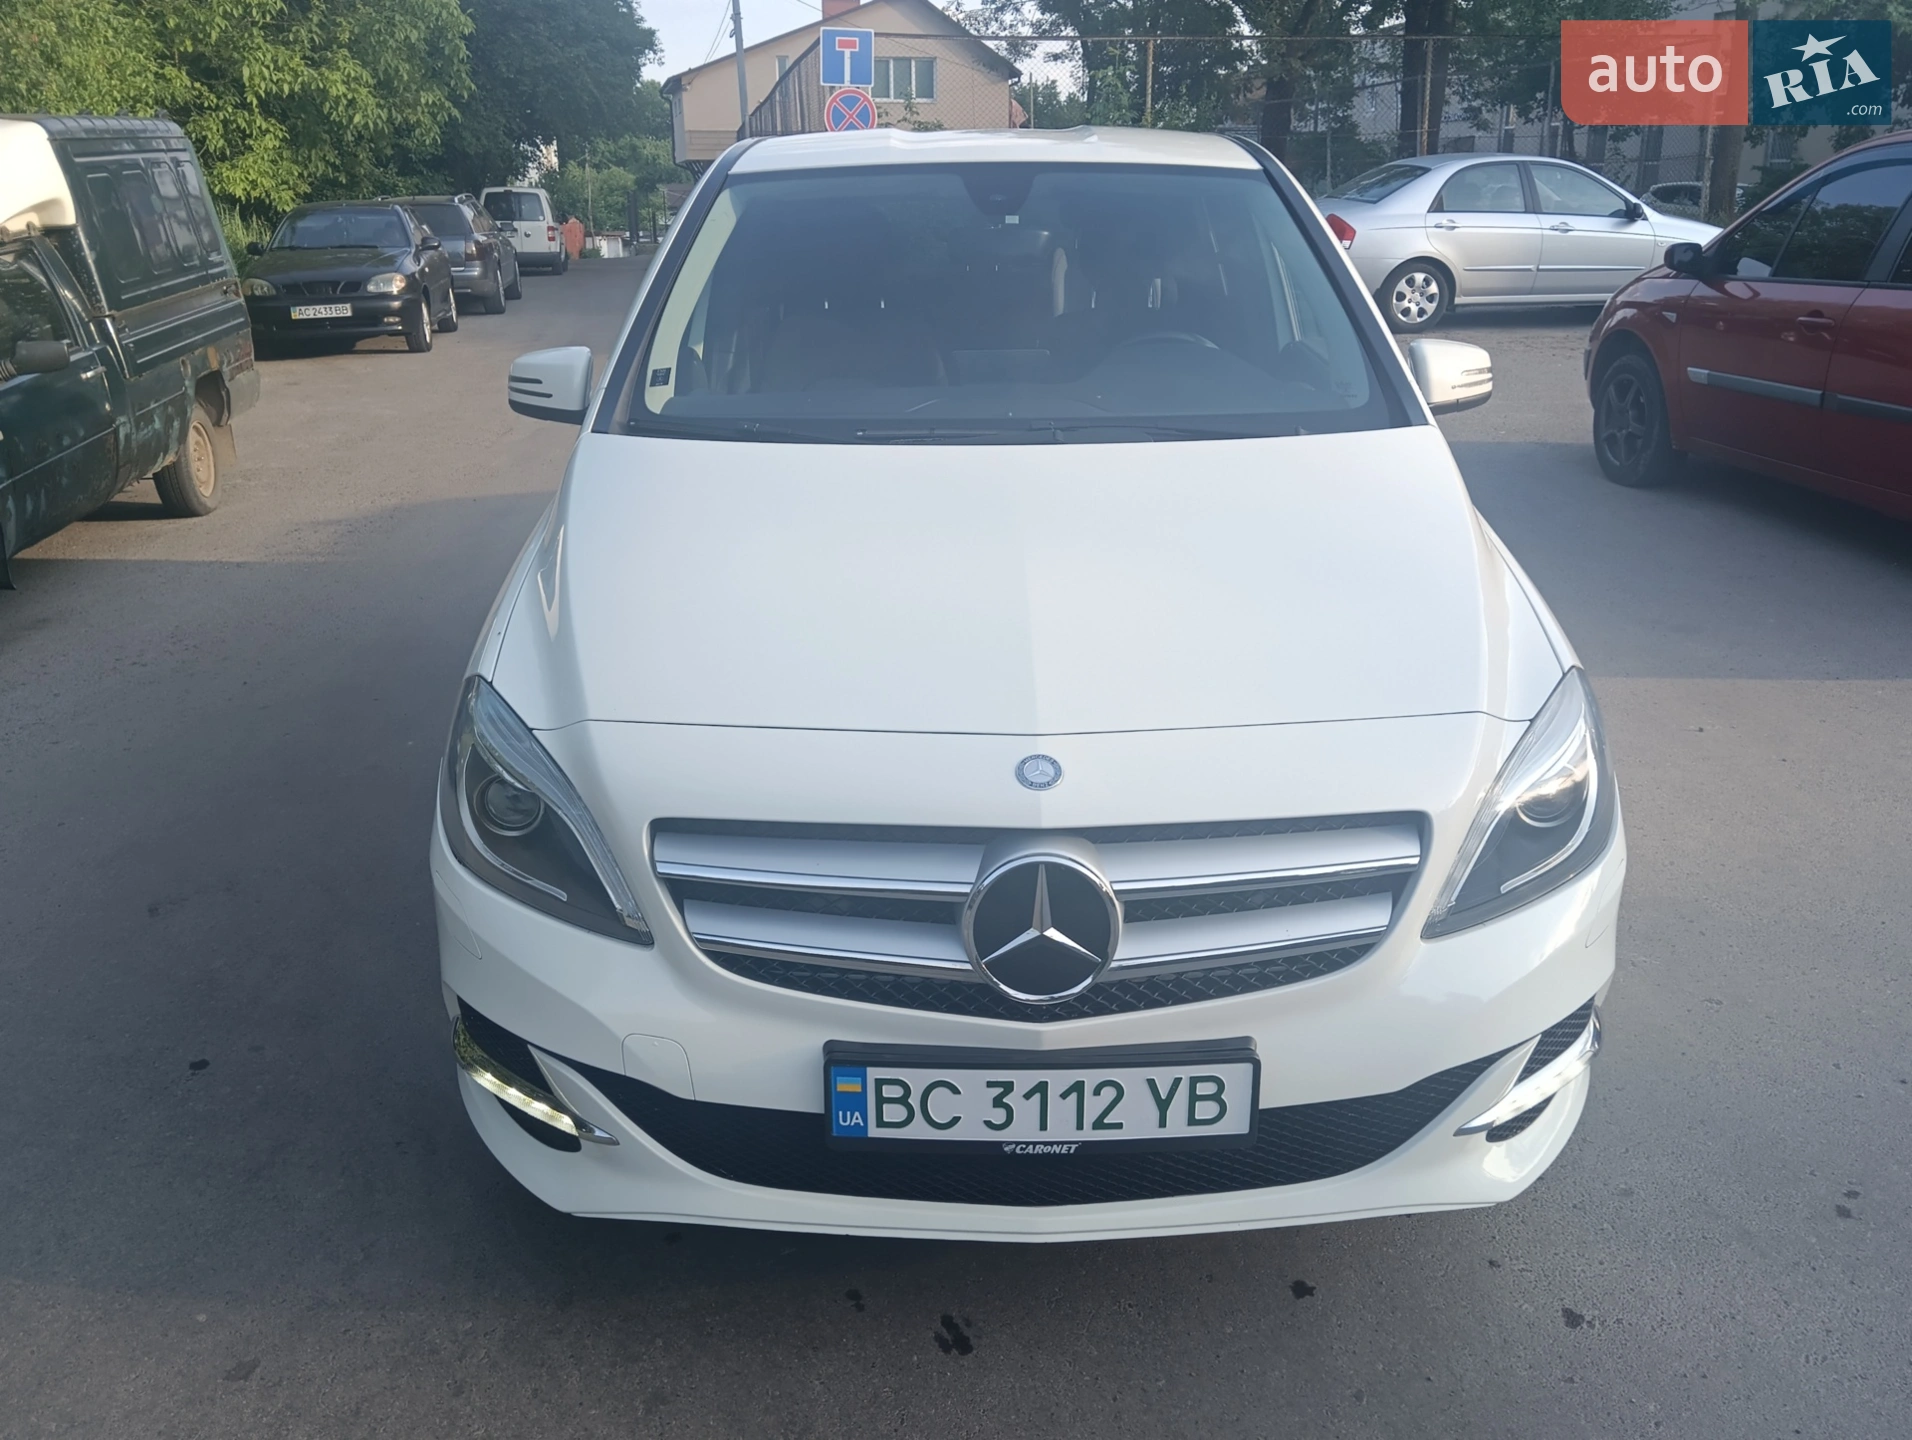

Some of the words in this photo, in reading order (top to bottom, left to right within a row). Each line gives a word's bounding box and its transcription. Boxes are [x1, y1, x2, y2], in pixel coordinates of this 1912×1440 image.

[298, 308, 311, 317] AC
[312, 307, 333, 317] 2433
[335, 306, 348, 315] BB
[874, 1078, 962, 1130] BC
[983, 1080, 1125, 1131] 3112
[1145, 1075, 1228, 1129] YB
[838, 1110, 864, 1127] UA
